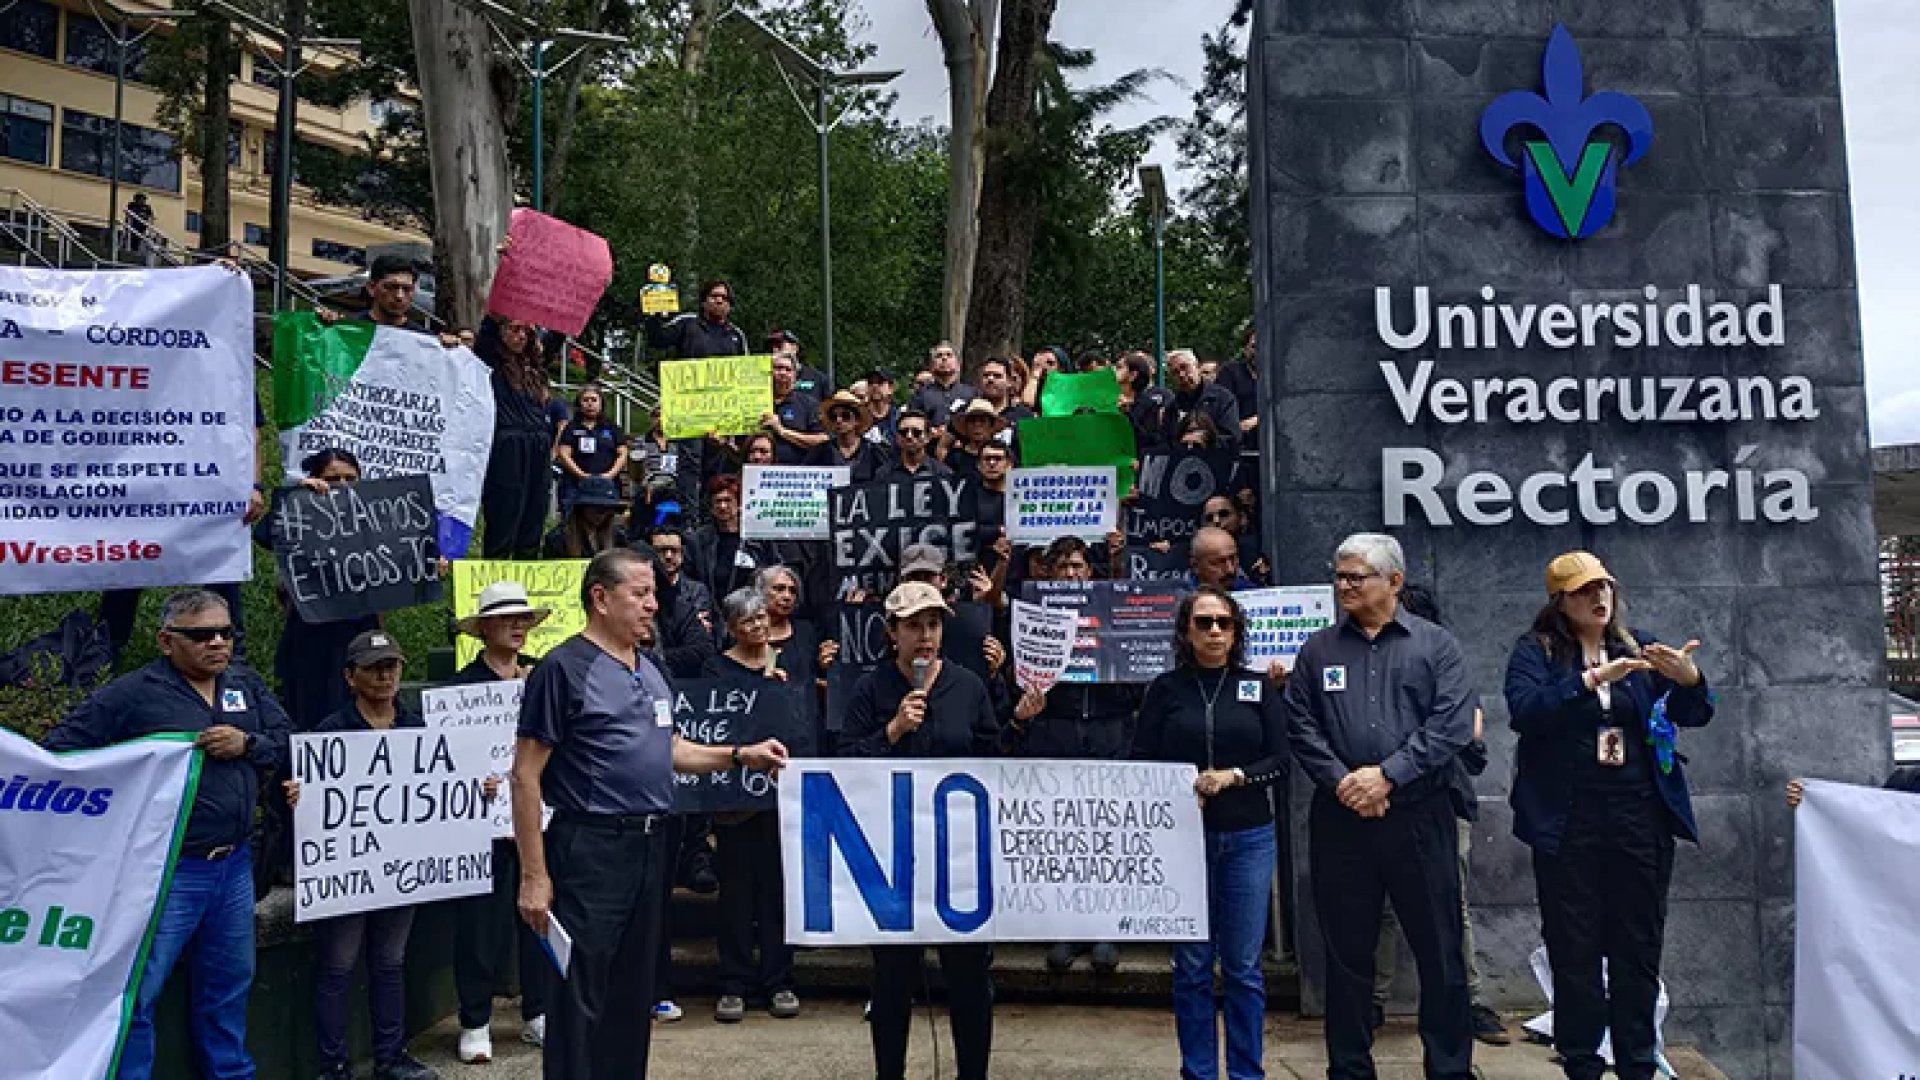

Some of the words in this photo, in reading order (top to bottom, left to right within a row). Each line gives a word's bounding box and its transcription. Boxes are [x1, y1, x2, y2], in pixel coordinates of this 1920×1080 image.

[1375, 284, 1785, 349] Universidad
[86, 322, 211, 349] CÓRDOBA
[2, 360, 150, 390] ESENTE
[1379, 361, 1820, 425] Veracruzana
[31, 409, 47, 423] A
[56, 409, 84, 423] LA
[92, 408, 193, 426] DECISIÓN
[202, 411, 226, 426] DE
[23, 430, 54, 444] DE
[62, 430, 185, 446] GOBIERNO.
[51, 463, 79, 478] SE
[87, 463, 187, 477] RESPETE
[194, 462, 220, 477] LA
[1014, 477, 1029, 489] LA
[1031, 475, 1108, 488] VERDADERA
[1138, 454, 1217, 505] NO
[1382, 445, 1819, 525] Rectoría
[836, 489, 870, 523] LA
[888, 480, 966, 520] LEY
[1019, 502, 1037, 513] NO
[1040, 501, 1073, 513] TEME
[1088, 500, 1104, 513] LA
[1023, 486, 1097, 500] EDUCACIÓN
[1019, 513, 1102, 526] RENOVACIÓN
[0, 540, 162, 565] Vresiste
[707, 688, 758, 715] LEY
[368, 737, 392, 776] A
[413, 736, 456, 774] LA
[0, 775, 113, 816] idos
[1000, 764, 1061, 797] MAS
[322, 777, 488, 830] DECISION
[998, 798, 1045, 826] MAS
[1053, 798, 1121, 828] FALTAS
[1123, 800, 1139, 829] A
[1141, 799, 1176, 830] LOS
[301, 836, 336, 868] DE
[350, 831, 381, 859] LA
[801, 772, 994, 934] NO
[1000, 828, 1089, 856] DERECHOS
[1093, 831, 1114, 856] DE
[1120, 831, 1153, 856] LOS
[299, 869, 375, 907] JUNTA
[396, 851, 493, 894] GOBIERNO
[1003, 856, 1165, 886] TRABAJADORES
[1000, 885, 1047, 914] MAS
[1056, 886, 1181, 914] MEDIOCRIDAD
[38, 905, 94, 950] la
[1118, 915, 1198, 937] #UVRESISTE
